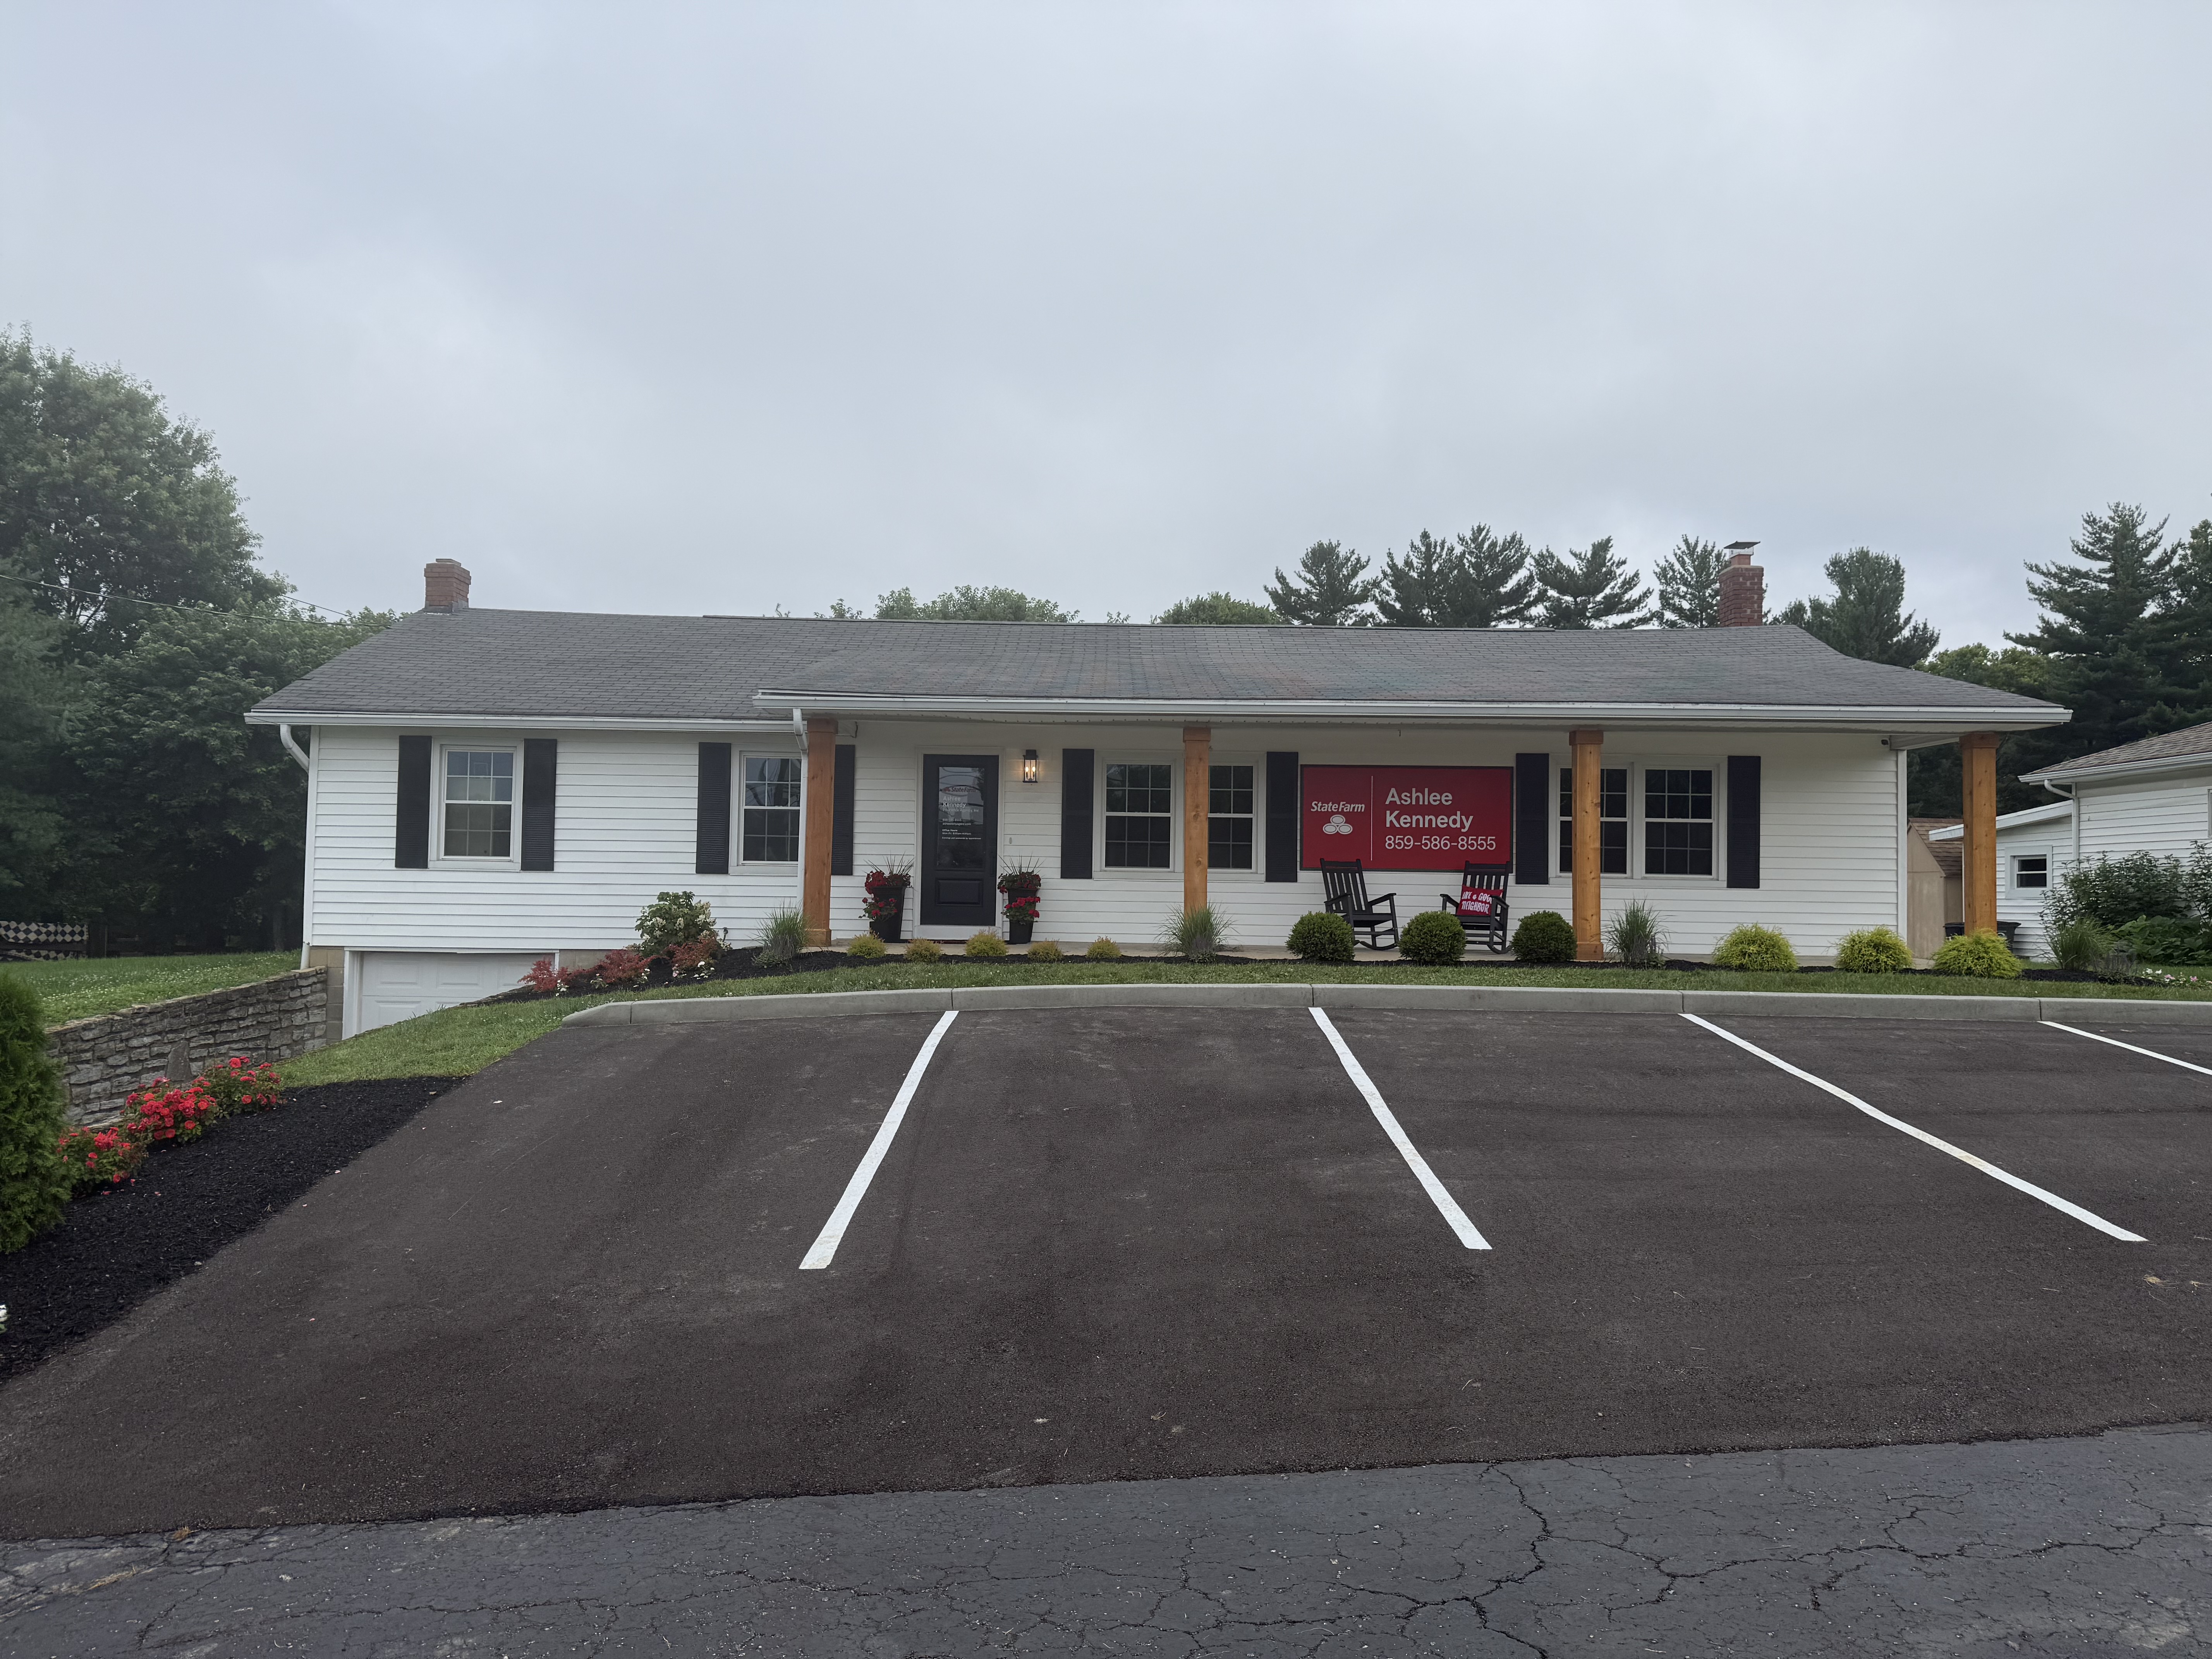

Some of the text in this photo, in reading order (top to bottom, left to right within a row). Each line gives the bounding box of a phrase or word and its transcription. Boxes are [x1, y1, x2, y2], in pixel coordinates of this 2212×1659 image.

[1385, 788, 1453, 805] Ashlee
[1385, 810, 1474, 832] Kennedy
[1385, 836, 1496, 850] 859-586-8555
[1461, 901, 1490, 914] NEIGHBOR
